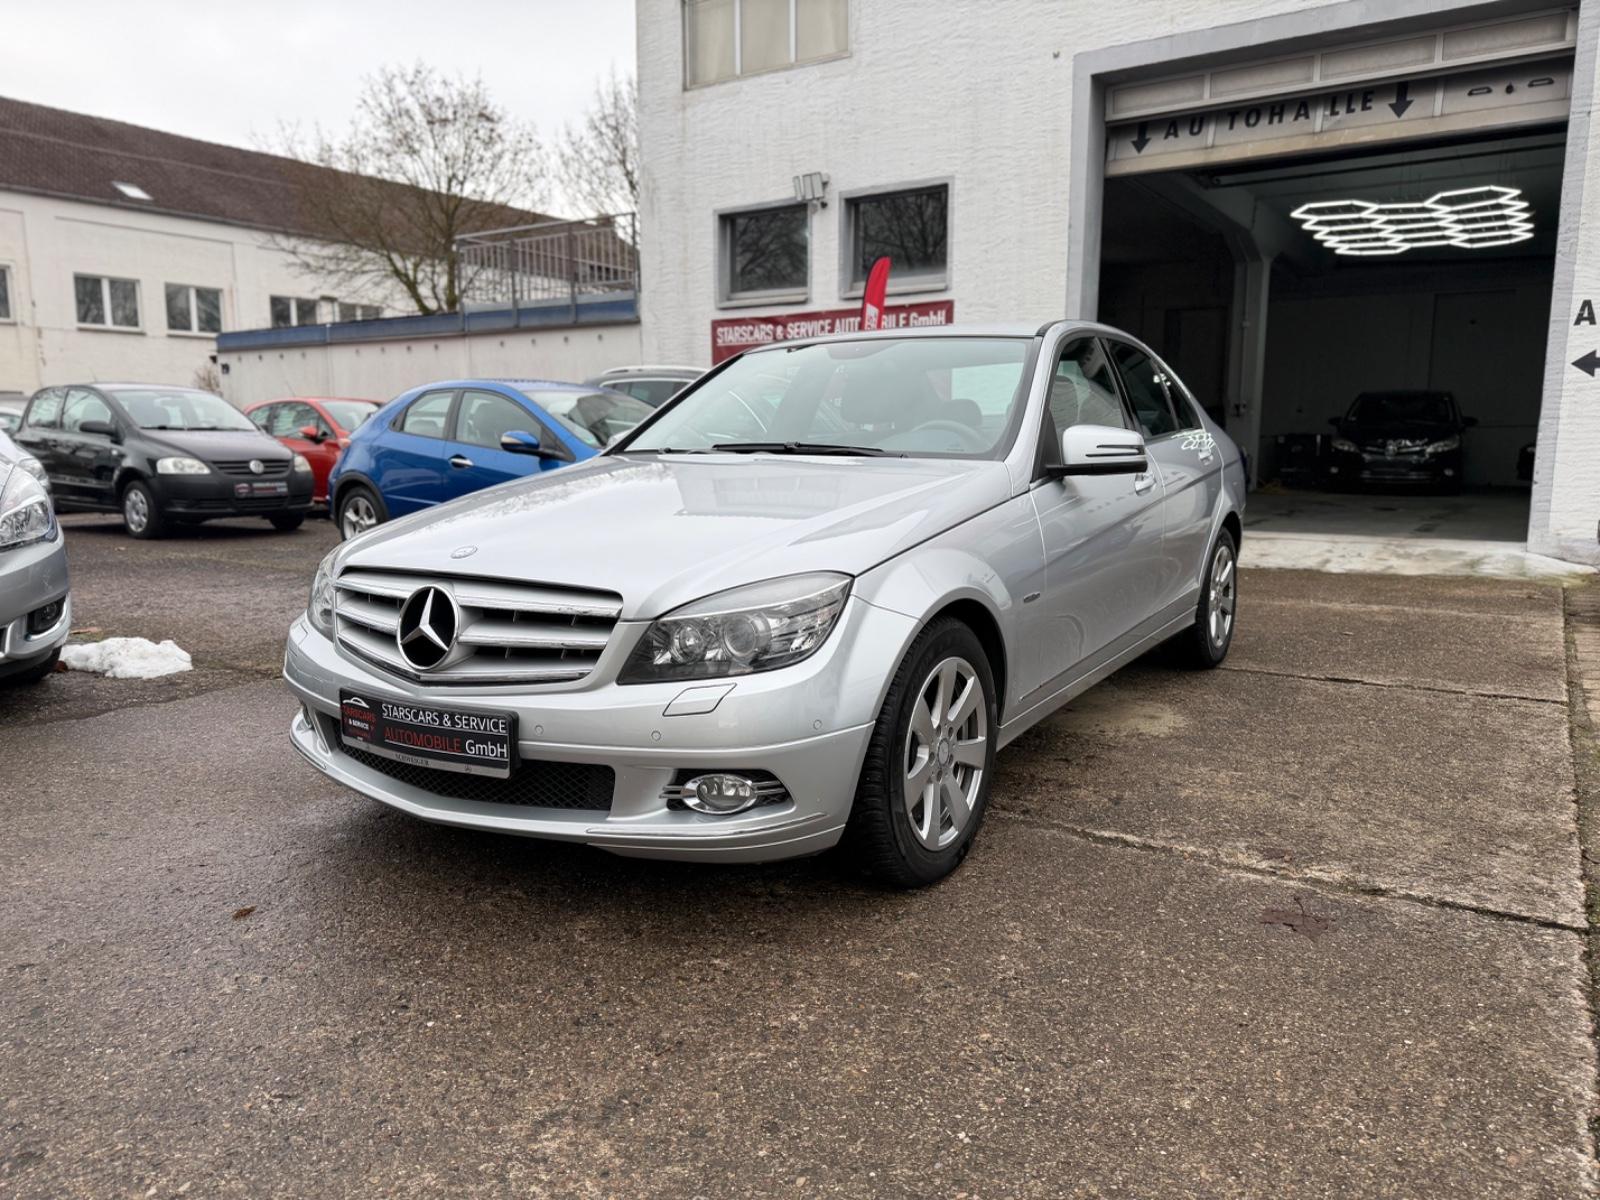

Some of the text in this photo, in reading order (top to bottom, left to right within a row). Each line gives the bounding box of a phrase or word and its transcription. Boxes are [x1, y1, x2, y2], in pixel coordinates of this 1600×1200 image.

[716, 324, 774, 344] STARSCARS
[776, 326, 784, 340] &
[787, 319, 833, 339] SERVICE
[381, 703, 507, 733] STARSCARS & SERVICE
[384, 727, 462, 752] AUTOMOBILE
[465, 739, 507, 757] GmbH
